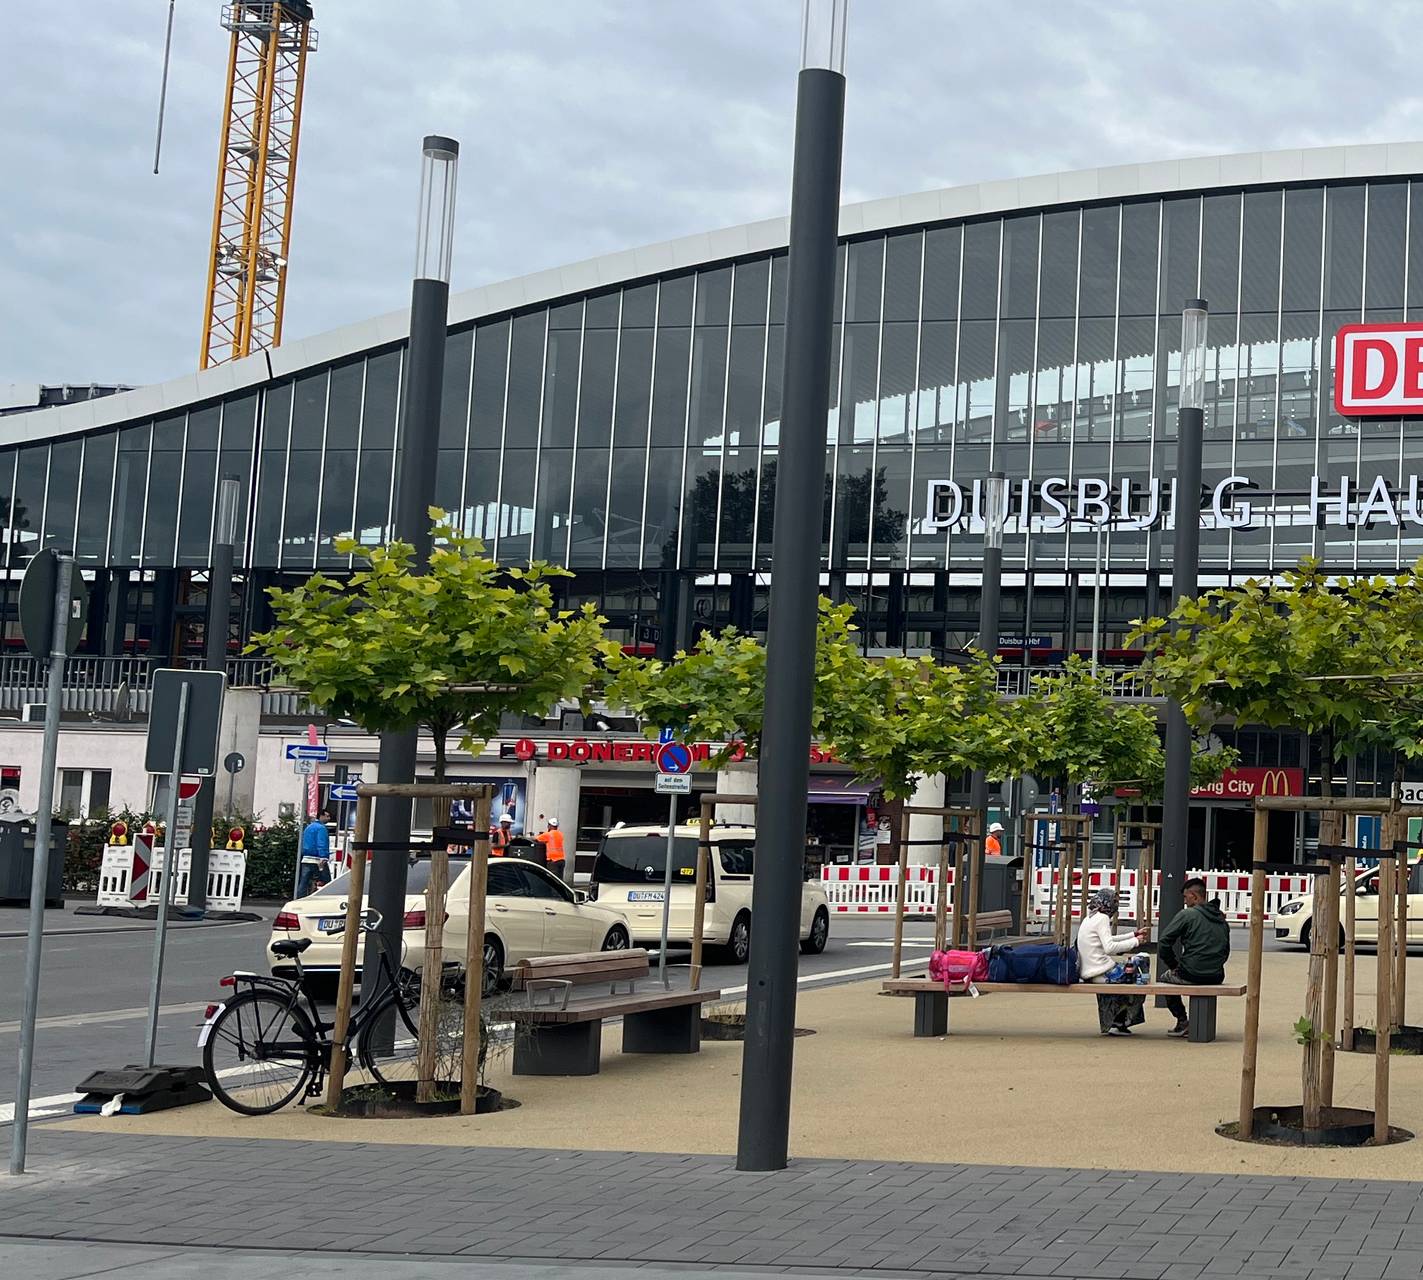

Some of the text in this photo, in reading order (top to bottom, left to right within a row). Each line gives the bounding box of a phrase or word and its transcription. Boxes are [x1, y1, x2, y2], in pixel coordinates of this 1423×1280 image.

[926, 475, 1252, 528] DUISBUG
[999, 637, 1028, 646] Duisbur
[1227, 779, 1255, 796] City
